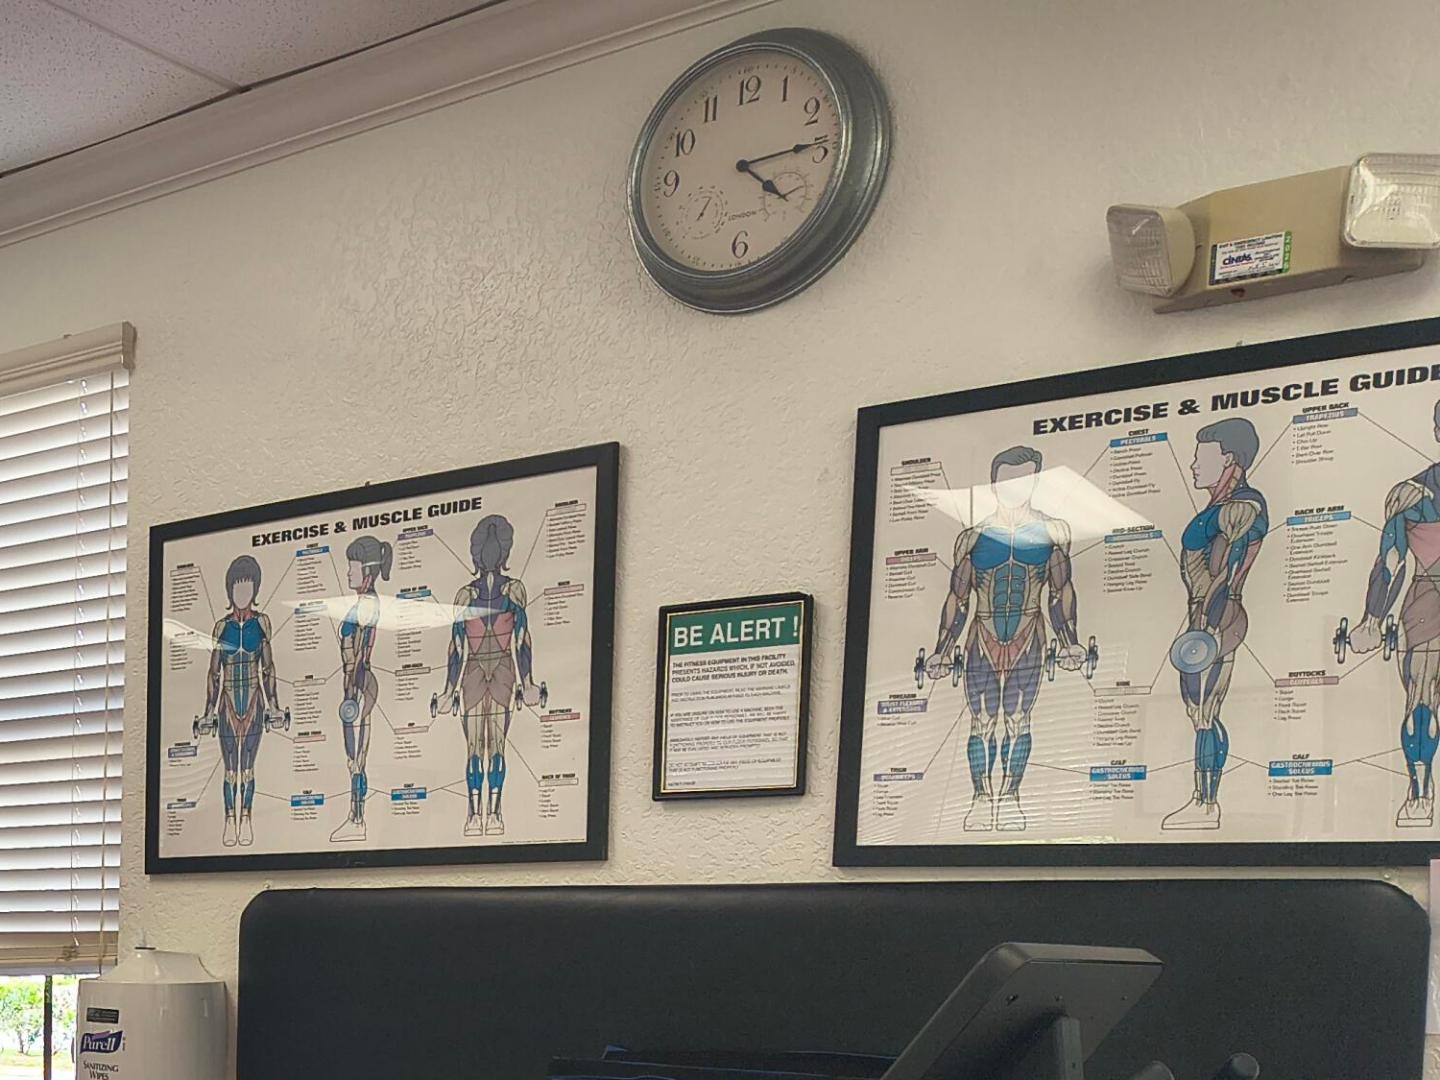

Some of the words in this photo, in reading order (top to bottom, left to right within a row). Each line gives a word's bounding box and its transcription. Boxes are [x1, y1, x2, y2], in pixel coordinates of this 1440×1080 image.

[738, 75, 761, 106] 12
[781, 75, 789, 103] 1
[703, 95, 718, 123] 11
[803, 96, 821, 126] 2
[675, 128, 696, 157] 10
[663, 169, 680, 198] 9
[731, 230, 749, 259] 6
[1033, 402, 1169, 435] EXERCISE
[1177, 398, 1201, 416] &
[1211, 378, 1340, 411] MUSCLE
[1302, 405, 1327, 413] UPPER
[1128, 428, 1149, 437] CHEST
[251, 523, 329, 547] EXERCISE
[333, 521, 347, 533] &
[352, 507, 422, 531] MUSCLE
[427, 497, 482, 518] GUIDE
[673, 625, 704, 648] BE
[709, 616, 786, 645] ALERT
[792, 615, 799, 637] !
[707, 657, 740, 666] EQUIPMENT
[761, 653, 786, 661] FACILITY
[711, 672, 736, 680] SERIOUS
[83, 1034, 116, 1052] Purell
[83, 1060, 119, 1073] SANITIZING
[89, 1069, 109, 1080] WIPES
